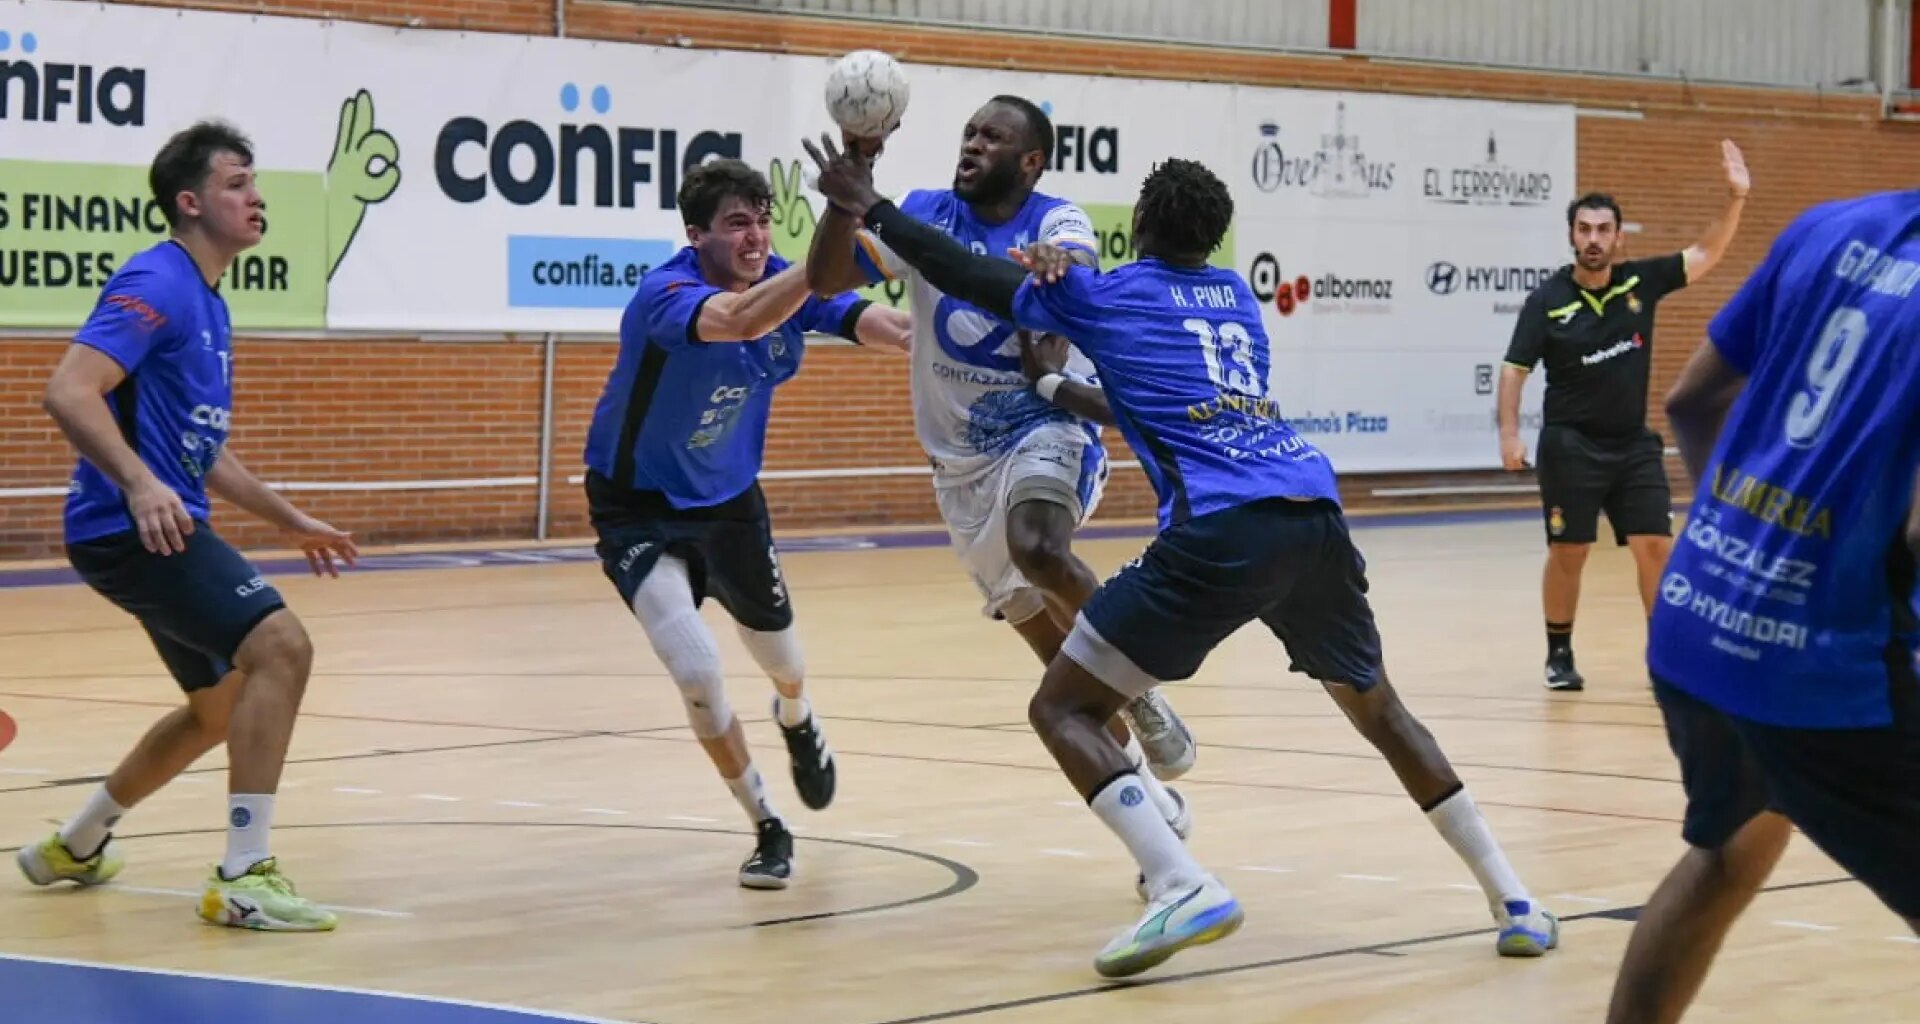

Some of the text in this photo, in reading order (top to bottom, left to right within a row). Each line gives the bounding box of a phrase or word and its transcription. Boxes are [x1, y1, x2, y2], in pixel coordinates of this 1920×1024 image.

[1315, 273, 1393, 300] albornoz
[1182, 318, 1263, 397] 13
[1785, 307, 1869, 450] 9
[1346, 409, 1388, 432] Pizza
[1690, 589, 1809, 649] HYUNDAI
